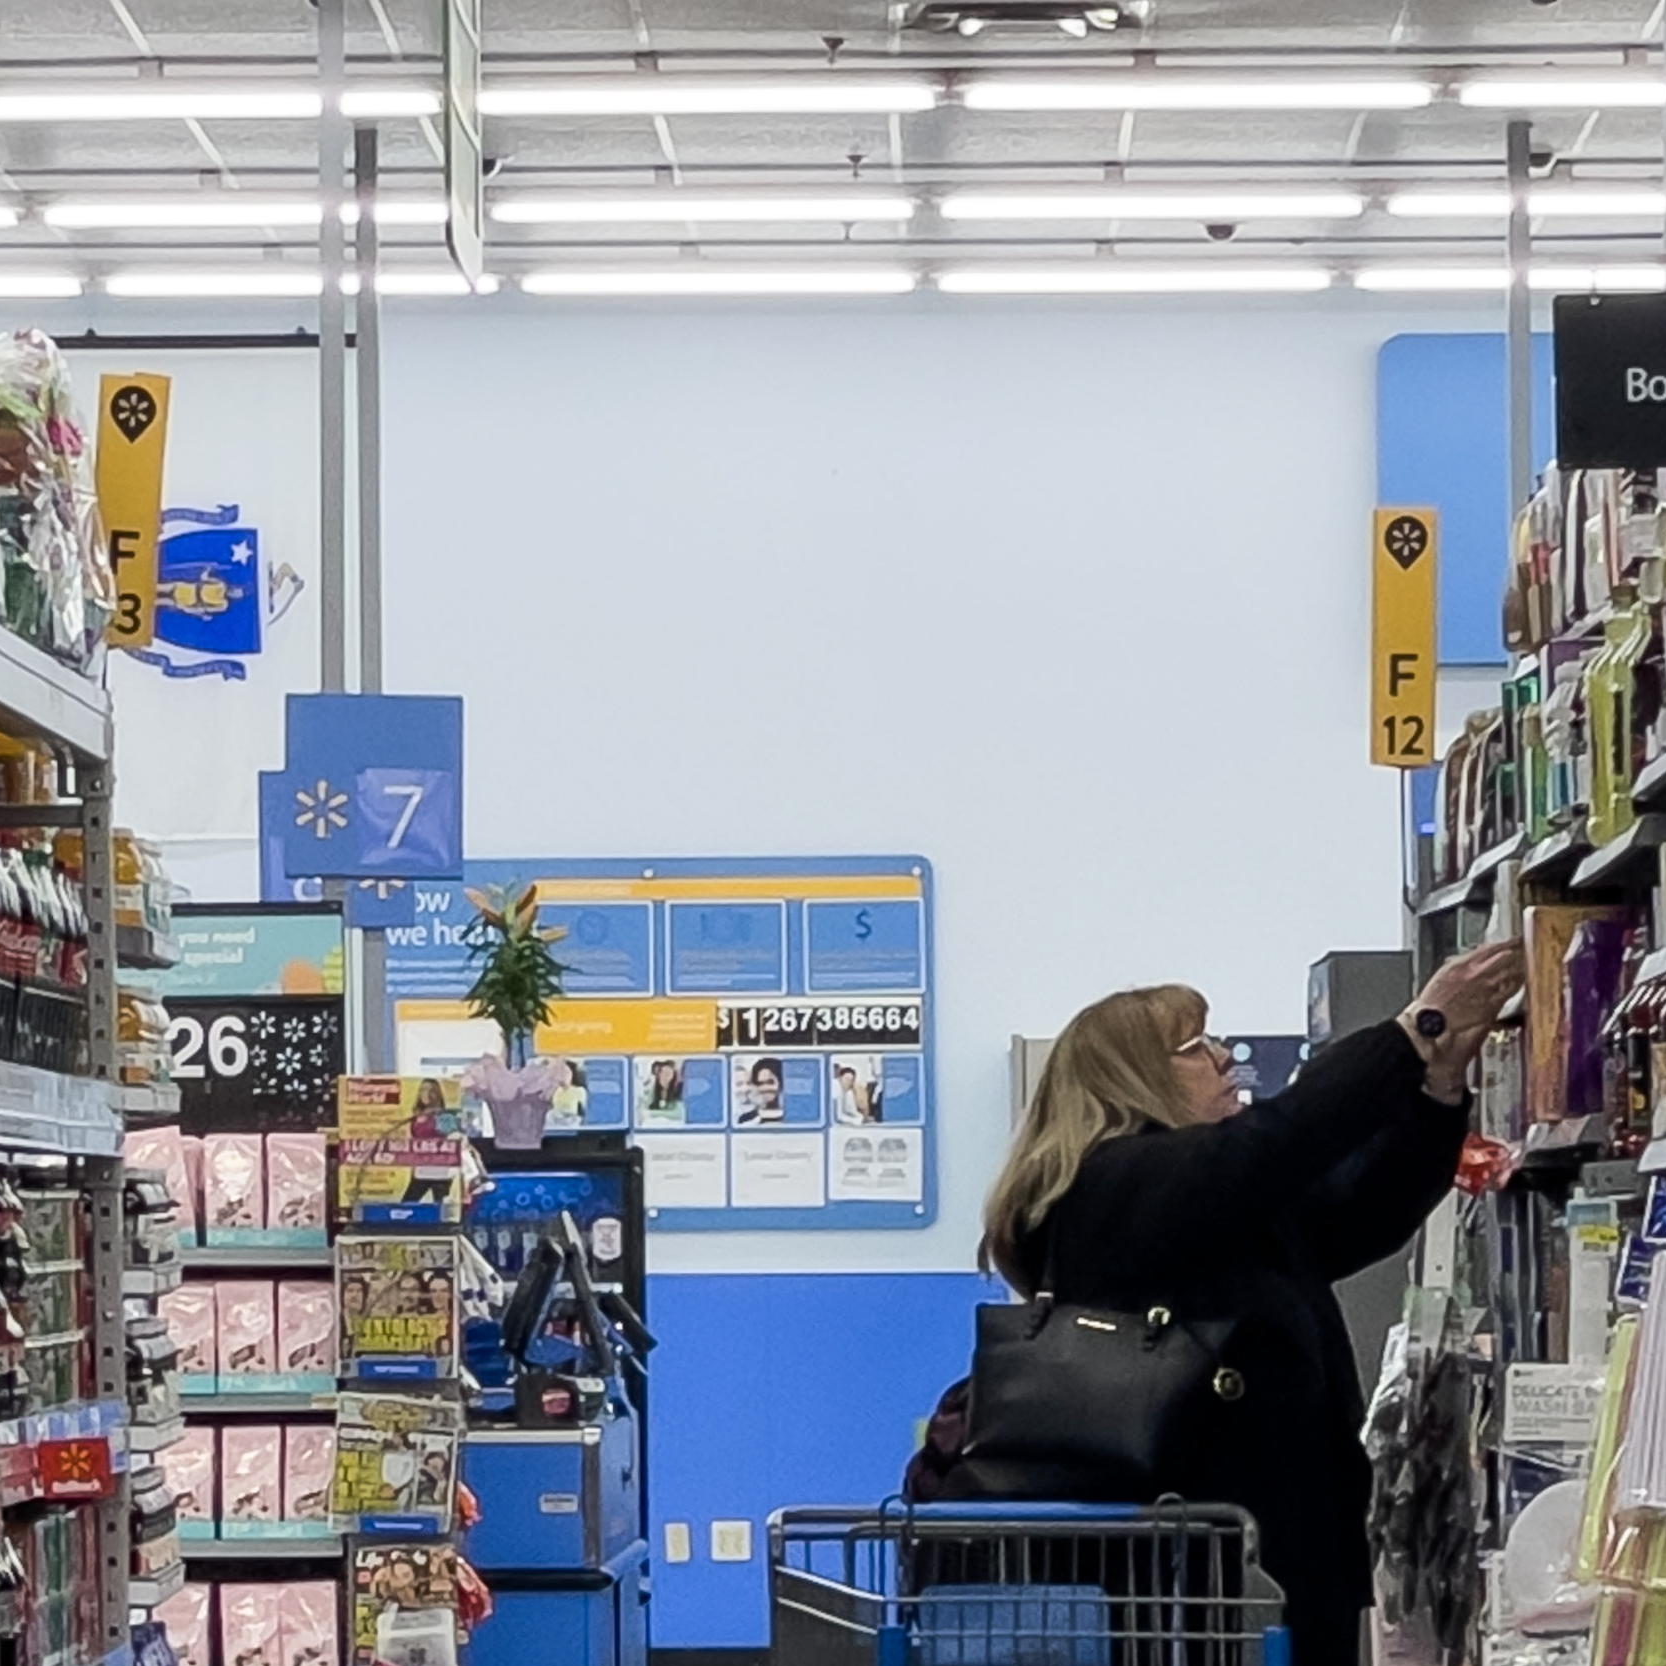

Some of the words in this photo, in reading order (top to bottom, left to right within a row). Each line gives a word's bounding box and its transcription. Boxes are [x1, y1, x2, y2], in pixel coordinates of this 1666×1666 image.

[110, 530, 140, 574] F
[113, 593, 142, 635] 3
[1389, 653, 1418, 696] F
[1382, 716, 1424, 756] 12
[383, 786, 424, 848] 7
[385, 925, 428, 947] we
[168, 1016, 249, 1078] 26
